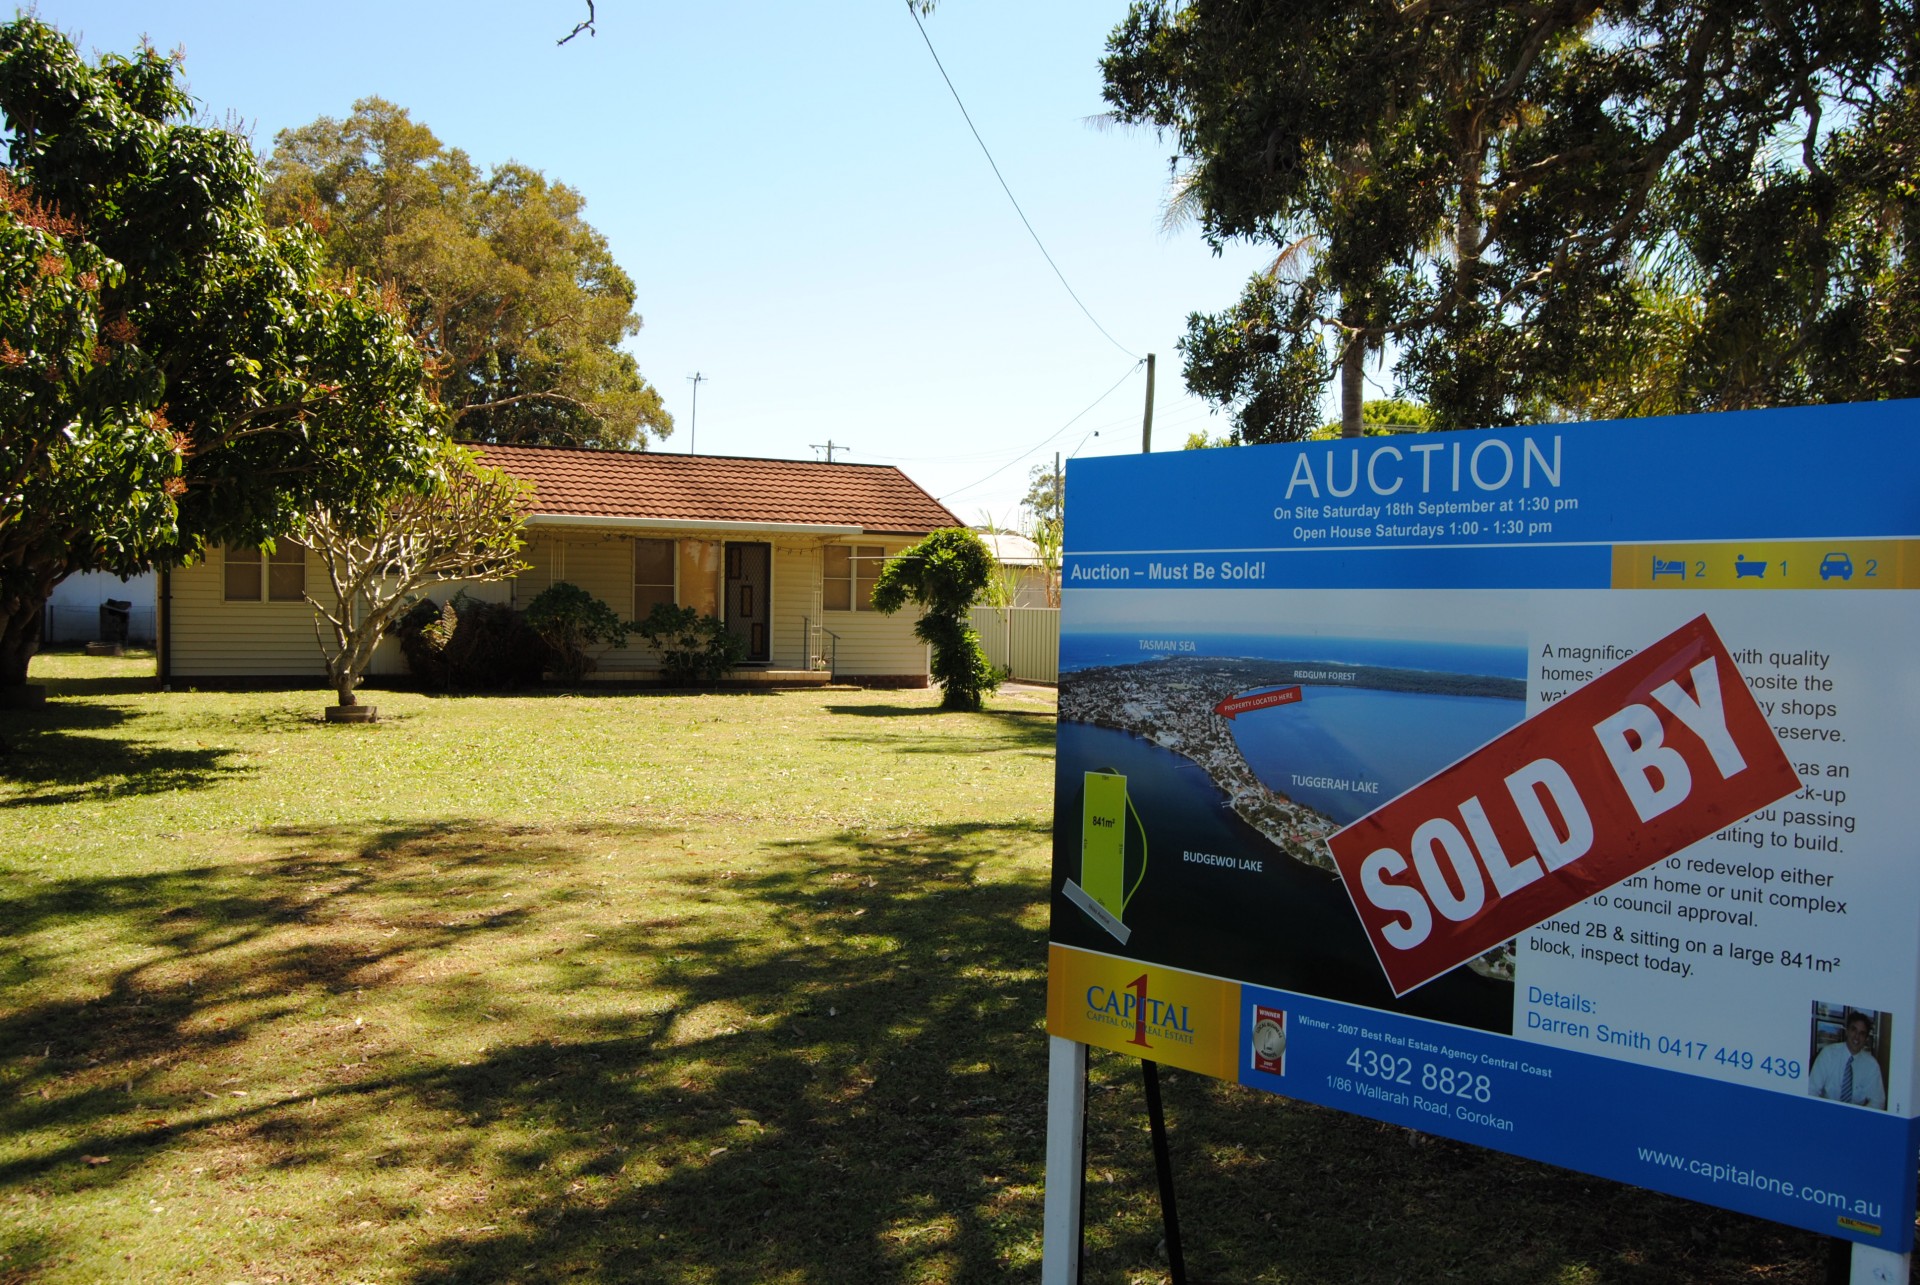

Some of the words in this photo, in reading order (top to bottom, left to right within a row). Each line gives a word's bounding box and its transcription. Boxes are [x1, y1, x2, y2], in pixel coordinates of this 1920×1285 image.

[1285, 435, 1562, 499] AUCTION
[1273, 506, 1291, 520] On
[1295, 504, 1319, 519] Site
[1323, 503, 1381, 520] Saturday
[1385, 501, 1413, 516] 18th
[1418, 499, 1495, 517] September
[1499, 499, 1513, 512] at
[1518, 496, 1550, 511] 1:30
[1554, 496, 1579, 513] pm
[1293, 526, 1326, 542] Open
[1330, 525, 1371, 539] House
[1375, 523, 1444, 539] Saturdays
[1449, 521, 1478, 536] 1:00
[1494, 520, 1524, 535] 1:30
[1528, 520, 1552, 536] pm
[1071, 563, 1130, 580] Auction
[1148, 564, 1188, 580] Must
[1193, 562, 1215, 579] Be
[1220, 561, 1265, 579] Sold!
[1695, 561, 1706, 577] 2
[1779, 561, 1788, 576] 1
[1865, 559, 1878, 576] 2
[1139, 639, 1176, 651] TASMAN
[1178, 640, 1196, 651] SEA
[1542, 643, 1553, 658] A
[1558, 645, 1637, 662] magnifice
[1769, 650, 1829, 670] quality
[1293, 670, 1326, 681] REDGUM
[1328, 671, 1356, 681] FOREST
[1542, 666, 1593, 681] homes
[1805, 675, 1833, 691] the
[1224, 700, 1251, 712] PROPERTY
[1252, 696, 1278, 707] LOCATED
[1278, 692, 1293, 702] HERE
[1781, 699, 1837, 719] shops
[1826, 765, 1849, 778] an
[1291, 775, 1349, 791] TUGGERAH
[1352, 780, 1379, 794] LAKE
[1360, 758, 1594, 950] SOLD
[1592, 656, 1748, 823] BY
[1783, 811, 1855, 833] passing
[1710, 827, 1764, 849] aiting
[1771, 832, 1788, 847] to
[1794, 833, 1843, 853] build.
[1183, 851, 1236, 869] BUDGEWOI
[1238, 857, 1263, 872] LAKE
[1687, 858, 1774, 883] redevelop
[1781, 867, 1834, 887] either
[1653, 875, 1701, 895] home
[1707, 884, 1725, 898] or
[1731, 887, 1763, 903] unit
[1769, 892, 1847, 914] complex
[1613, 897, 1672, 915] council
[1677, 904, 1758, 927] approval.
[1530, 936, 1575, 959] block,
[1581, 944, 1639, 966] inspect
[1645, 954, 1694, 978] today.
[1585, 922, 1607, 939] 2B
[1613, 926, 1625, 941] &
[1630, 929, 1679, 953] sitting
[1685, 940, 1707, 953] on
[1712, 944, 1723, 956] a
[1730, 942, 1774, 966] large
[1780, 950, 1841, 973] 841m²
[1086, 985, 1194, 1034] CAPITAL
[1126, 973, 1153, 1049] 1
[1529, 986, 1596, 1014] Details:
[1259, 1009, 1281, 1019] WINNER
[1165, 1029, 1194, 1045] ESTATE
[1298, 1014, 1330, 1030] Winner
[1337, 1023, 1358, 1036] 2007
[1361, 1028, 1382, 1042] Best
[1384, 1033, 1405, 1046] Real
[1408, 1038, 1438, 1053] Estate
[1440, 1045, 1478, 1064] Agency
[1481, 1054, 1518, 1071] Central
[1521, 1063, 1552, 1078] Coast
[1528, 1011, 1589, 1039] Darren
[1596, 1024, 1651, 1050] Smith
[1658, 1036, 1708, 1061] 0417
[1714, 1047, 1753, 1070] 449
[1760, 1056, 1800, 1079] 439
[1346, 1047, 1412, 1085] 4392
[1422, 1063, 1491, 1103] 8828
[1326, 1075, 1352, 1092] 1/86
[1355, 1082, 1409, 1106] Wallarah
[1413, 1095, 1451, 1118] Road,
[1456, 1106, 1514, 1132] Gorokan
[1637, 1147, 1881, 1218] www.capitalone.com.au
